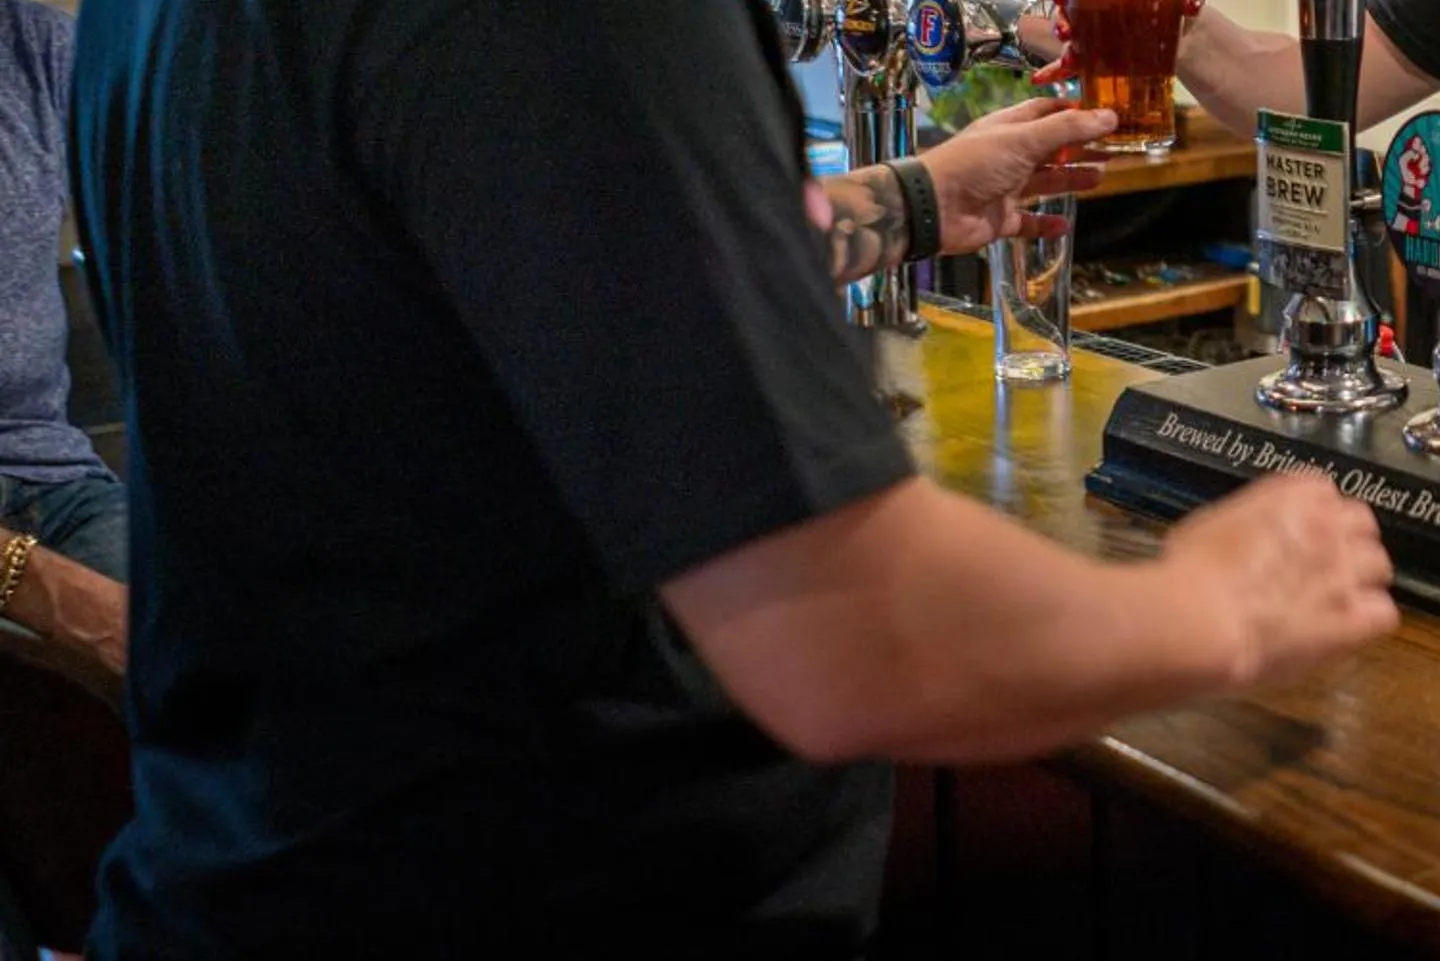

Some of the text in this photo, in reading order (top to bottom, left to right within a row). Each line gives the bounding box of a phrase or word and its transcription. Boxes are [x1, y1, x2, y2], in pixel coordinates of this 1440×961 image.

[1266, 153, 1325, 179] MASTER
[1266, 176, 1325, 207] BREW
[1157, 412, 1229, 455] Brewed
[1228, 433, 1255, 467] by
[1340, 468, 1411, 513] Oldest
